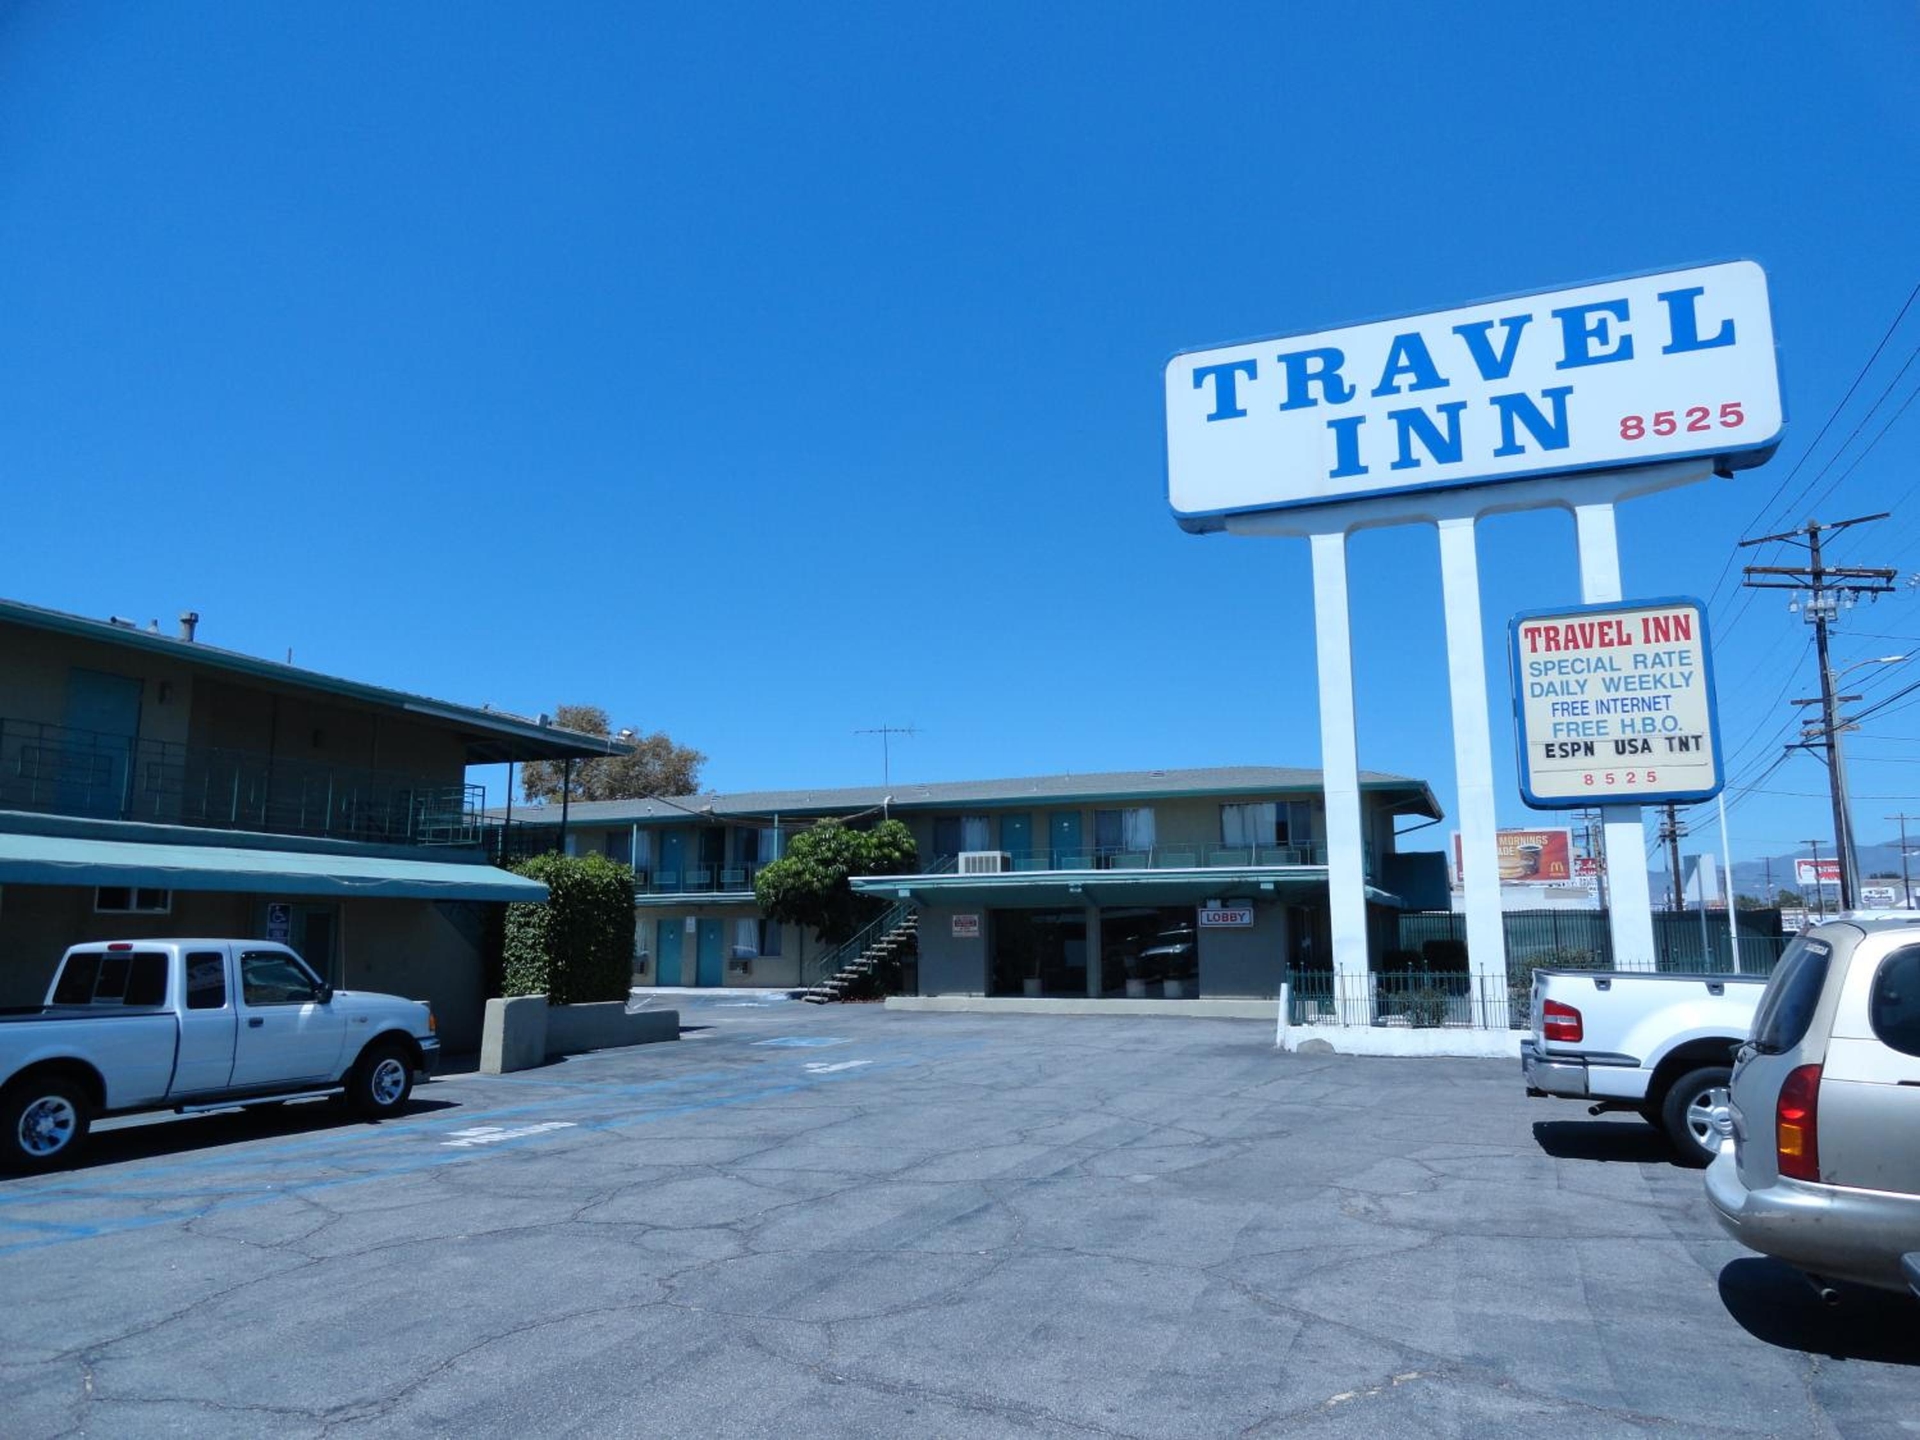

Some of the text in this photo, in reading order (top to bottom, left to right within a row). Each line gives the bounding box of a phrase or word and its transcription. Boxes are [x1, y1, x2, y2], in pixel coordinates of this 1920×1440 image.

[1192, 285, 1737, 422] TRAVEL
[1326, 385, 1574, 479] INN
[1618, 401, 1745, 441] 8525
[1524, 613, 1692, 654] TRAVEL INN
[1529, 650, 1693, 678] SPECIAL RATE
[1530, 671, 1694, 698] DAILY WEEKLY
[1551, 694, 1672, 717] FREE INTERNET
[1552, 715, 1683, 738] FREE H.B.O.
[1545, 734, 1703, 759] ESPN USA TNT
[1498, 847, 1515, 856] ADE
[1499, 835, 1549, 846] MORNINGS
[1206, 912, 1246, 922] LOBBY
